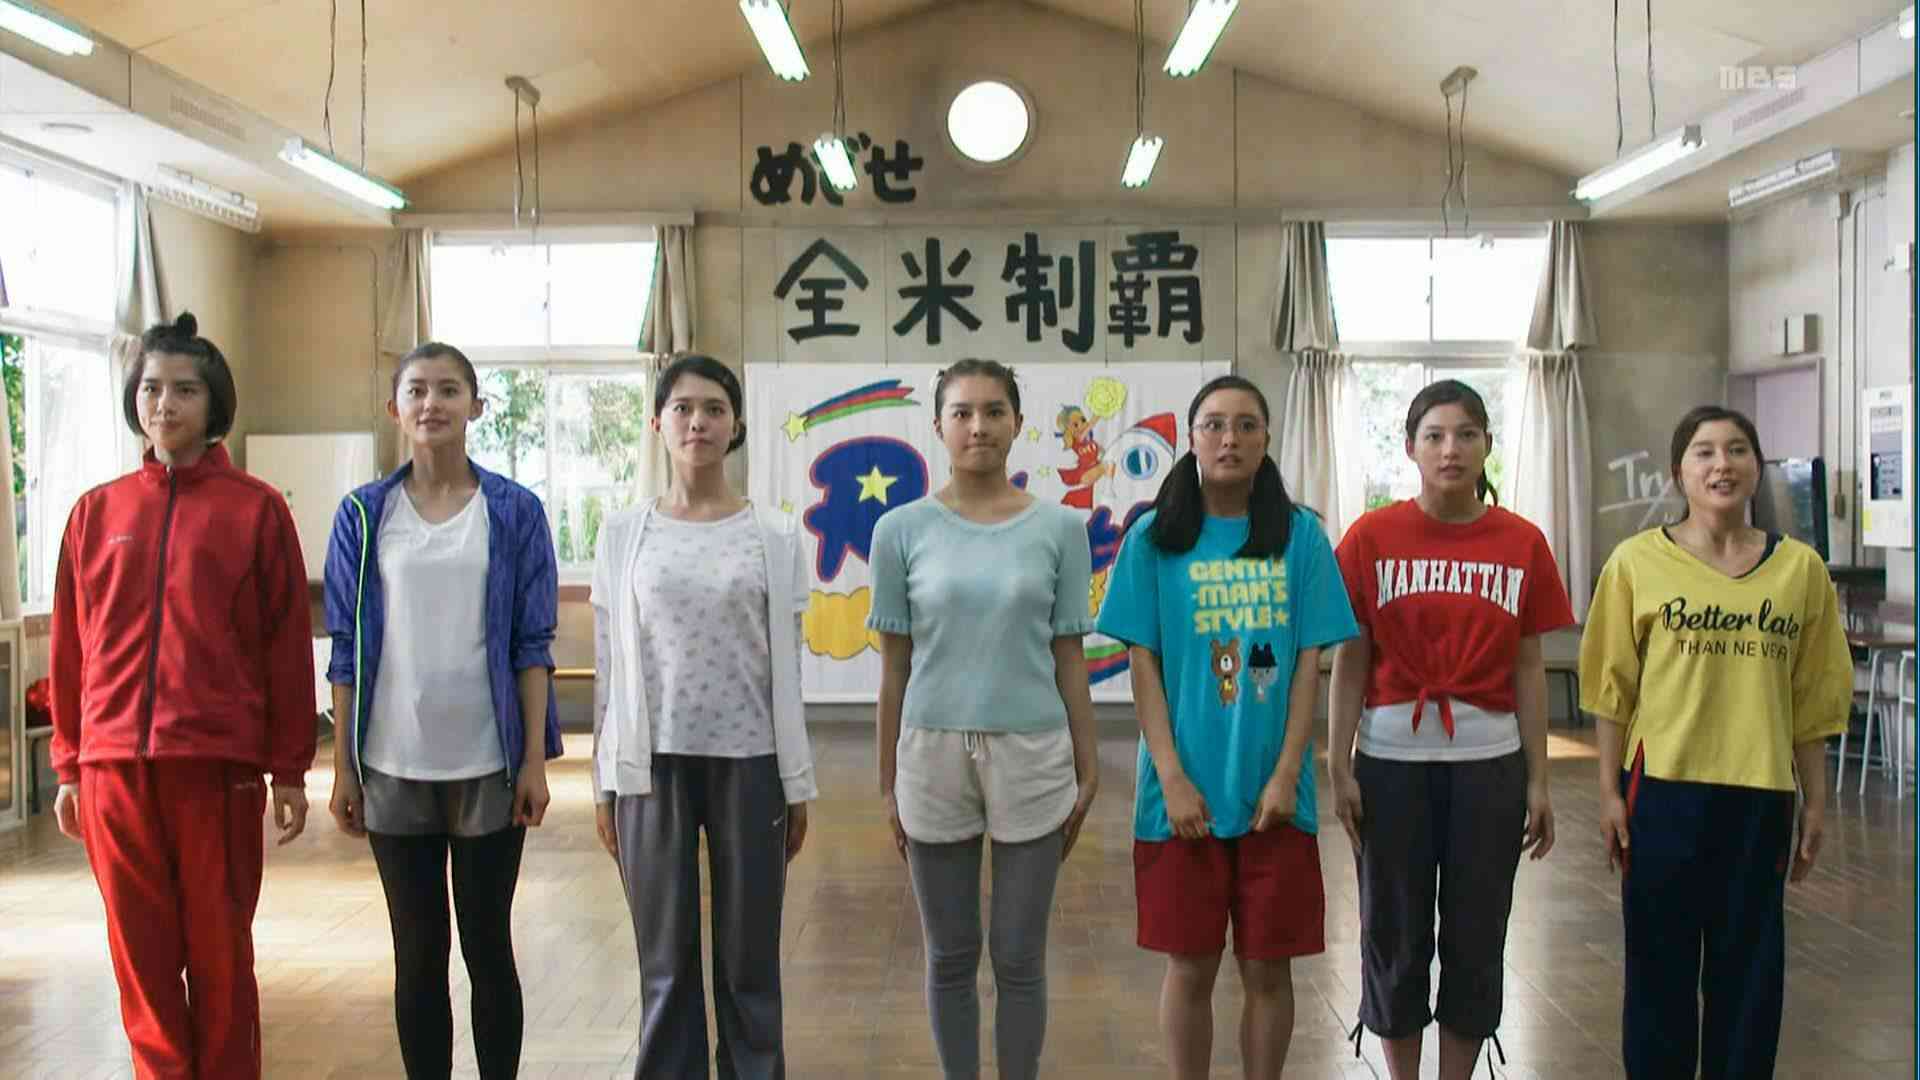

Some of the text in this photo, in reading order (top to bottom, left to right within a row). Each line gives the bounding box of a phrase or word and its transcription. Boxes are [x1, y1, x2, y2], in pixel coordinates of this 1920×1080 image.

[773, 231, 1205, 354] 全米制覇
[1607, 449, 1677, 531] Try
[1188, 557, 1287, 582] GENTLE
[1375, 558, 1525, 618] MANHATTAN
[1658, 596, 1753, 633] Better
[1677, 638, 1727, 656] THAN
